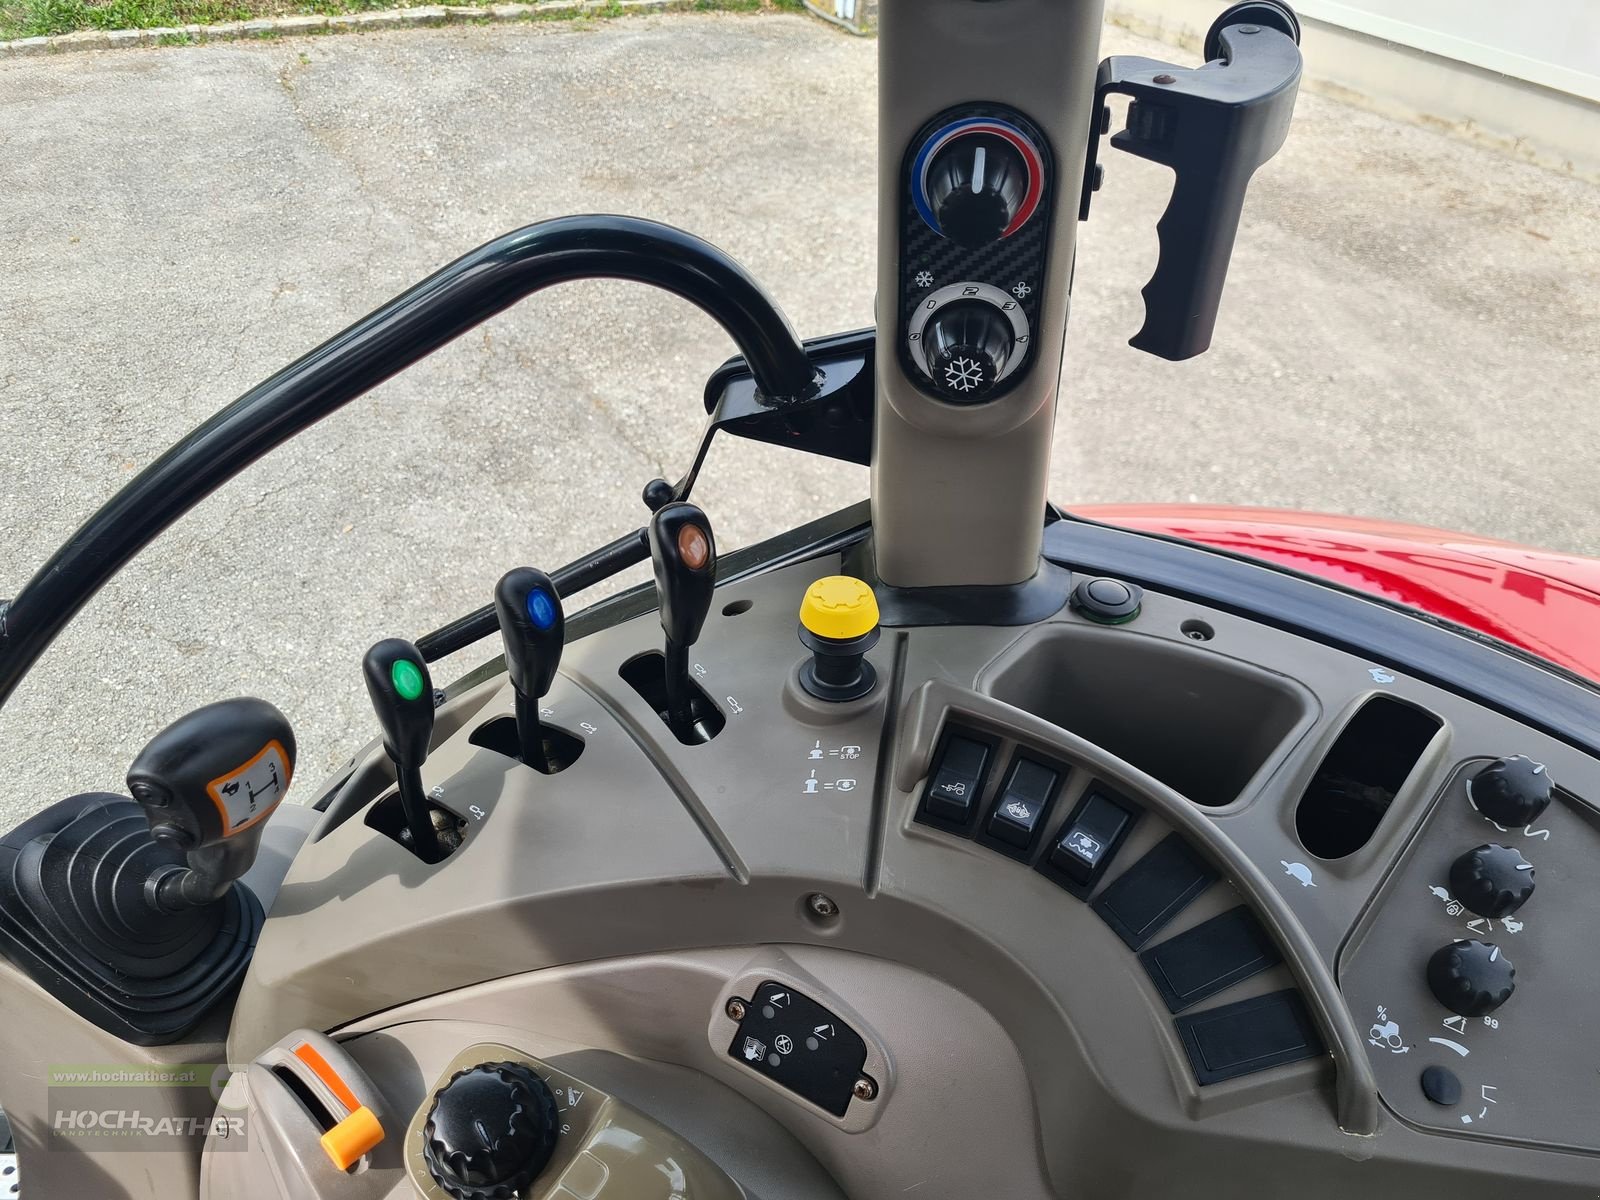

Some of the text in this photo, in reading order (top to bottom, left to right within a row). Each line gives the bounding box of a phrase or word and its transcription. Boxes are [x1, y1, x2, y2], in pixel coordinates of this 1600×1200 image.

[962, 287, 979, 296] 2
[1002, 302, 1017, 311] 3
[268, 762, 276, 772] 3
[250, 804, 257, 813] 2
[1483, 1016, 1499, 1029] 99
[560, 1123, 571, 1136] 10
